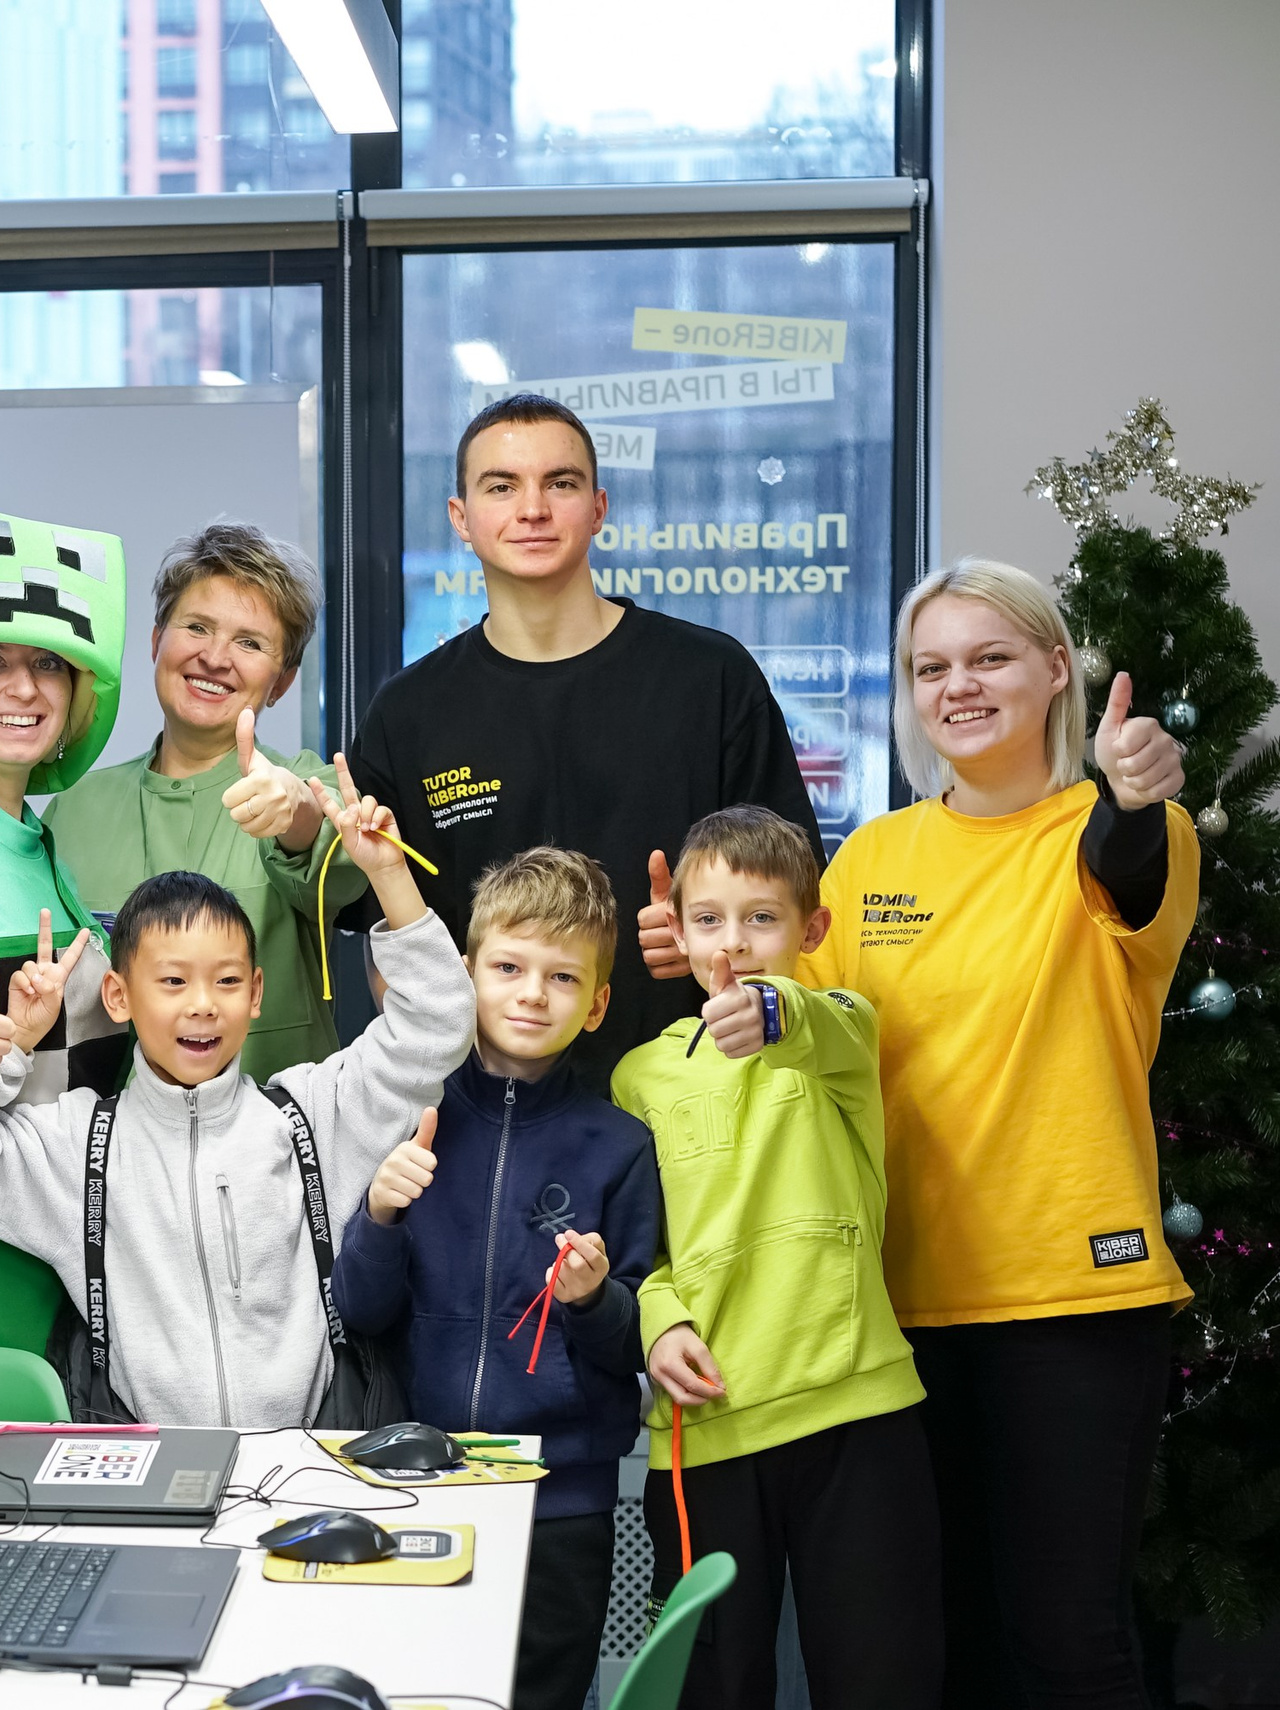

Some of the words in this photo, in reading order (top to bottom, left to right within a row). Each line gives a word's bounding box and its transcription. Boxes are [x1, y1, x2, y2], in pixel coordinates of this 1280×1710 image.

[422, 766, 471, 792] TUTOR
[426, 779, 502, 807] KIBERone
[462, 808, 493, 821] смысл
[863, 909, 934, 923] IBERone
[89, 1110, 112, 1174] KERRY
[279, 1101, 316, 1167] KERRY
[88, 1178, 103, 1247] KERRY
[305, 1172, 329, 1243] KERRY
[1113, 1245, 1141, 1258] ONE
[89, 1277, 105, 1343] KERRY
